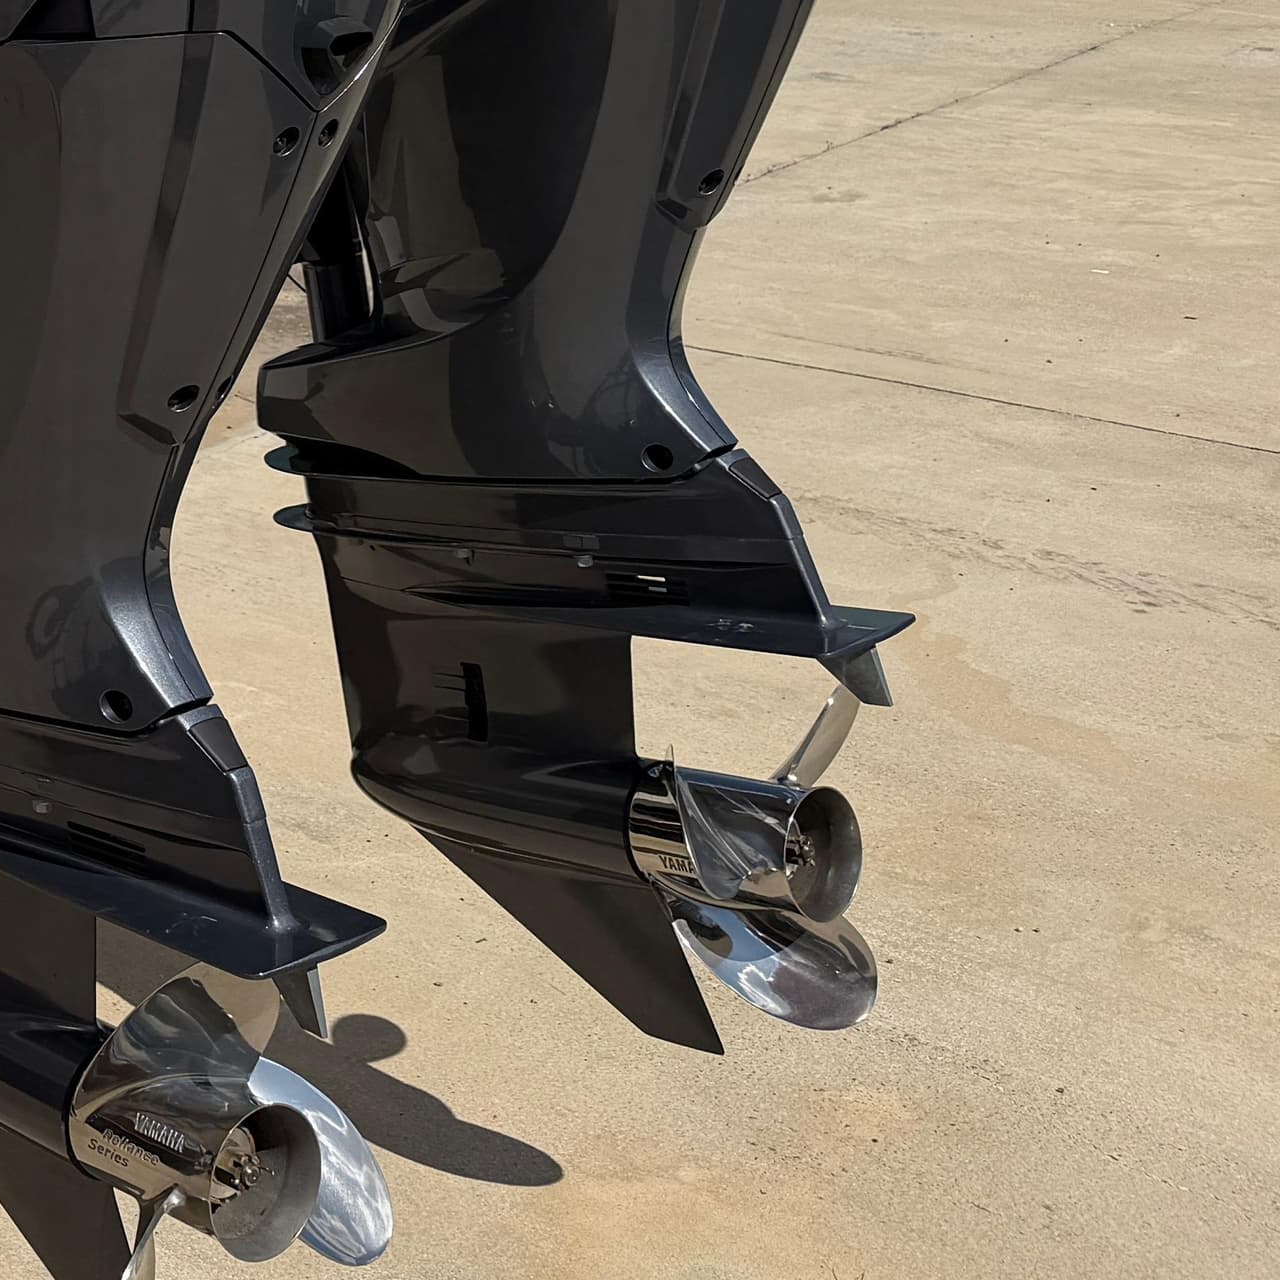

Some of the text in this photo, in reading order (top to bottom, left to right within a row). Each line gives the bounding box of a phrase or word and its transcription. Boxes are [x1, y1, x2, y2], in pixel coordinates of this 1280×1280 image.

[658, 854, 696, 875] YAMA
[102, 1128, 161, 1167] Reliance
[134, 1111, 186, 1153] YAMAHA
[87, 1138, 130, 1168] Series
